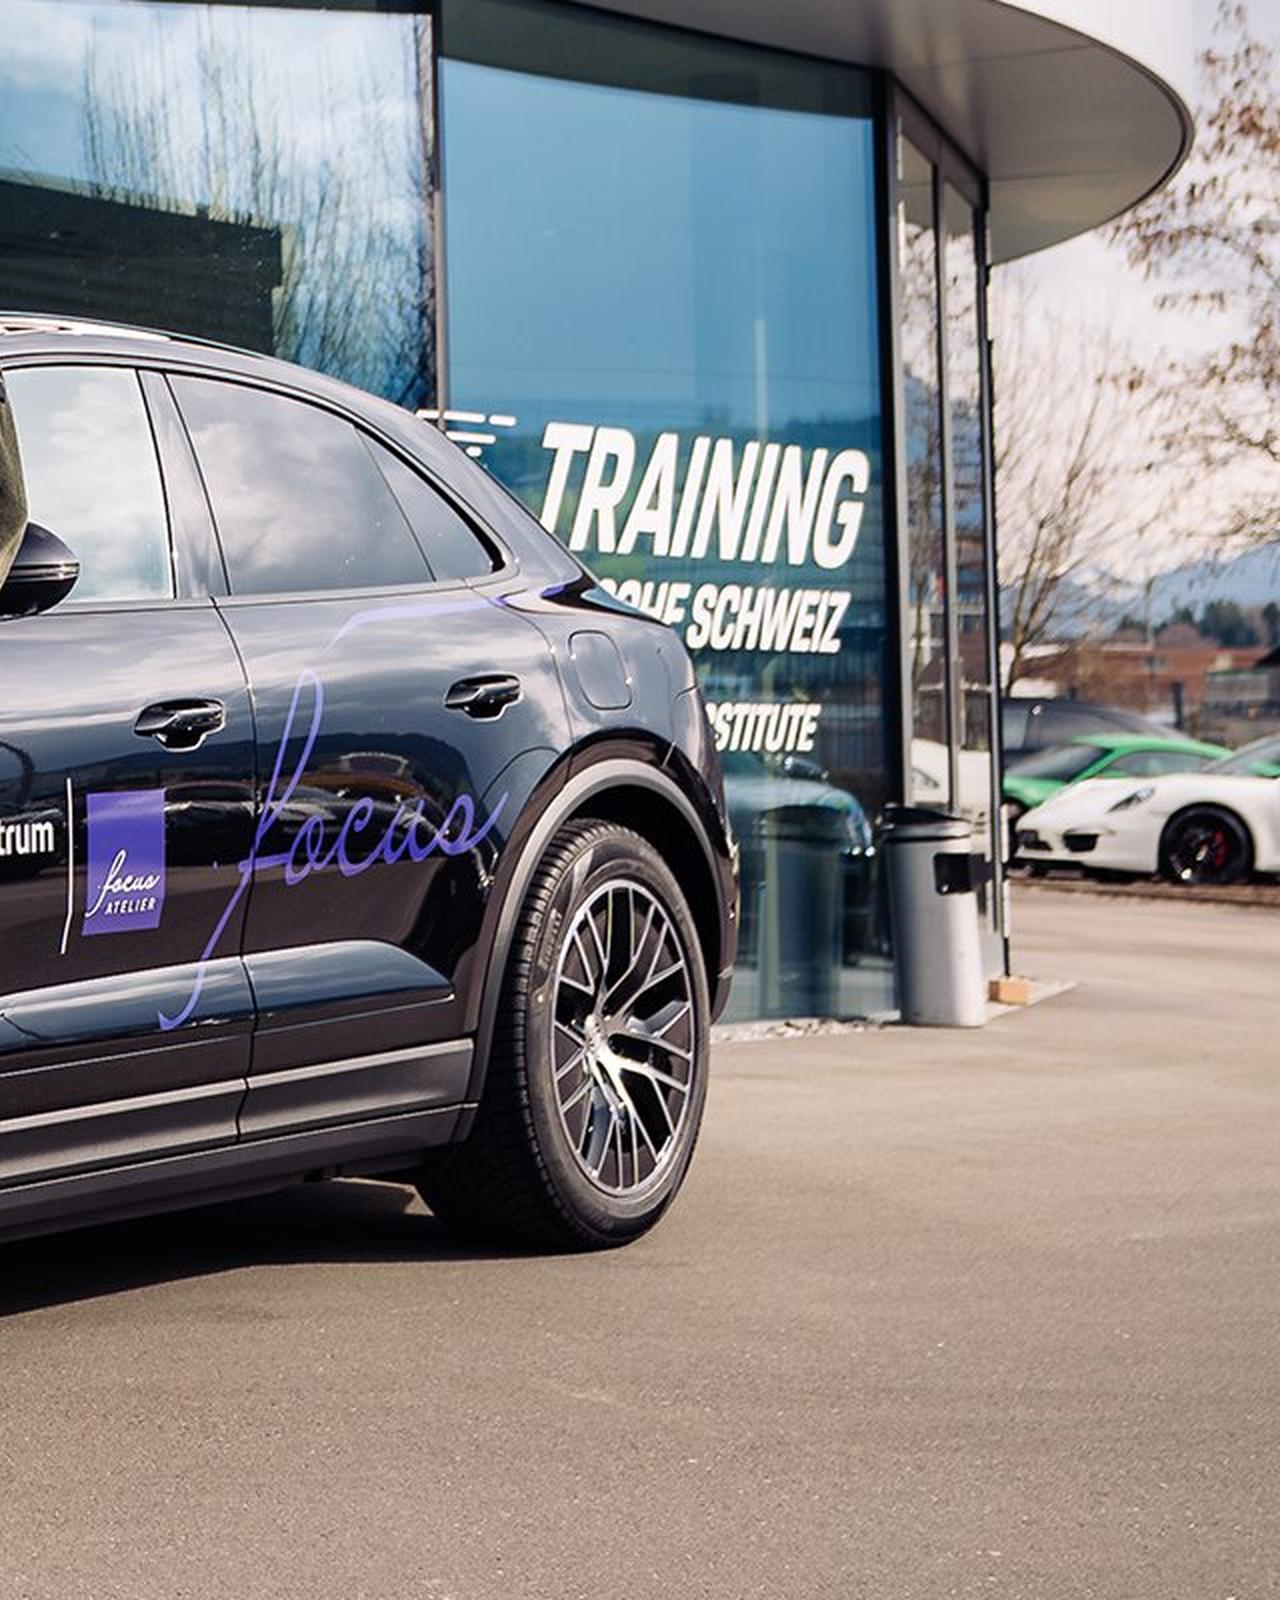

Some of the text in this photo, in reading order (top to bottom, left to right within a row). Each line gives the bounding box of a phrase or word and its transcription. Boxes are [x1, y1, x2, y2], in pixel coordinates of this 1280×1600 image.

[540, 421, 870, 569] TRAINING
[686, 584, 851, 653] SCHWEIZ
[705, 703, 821, 752] STITUTE
[85, 849, 160, 918] focus
[158, 668, 508, 1031] focus
[105, 897, 157, 915] ATELIER
